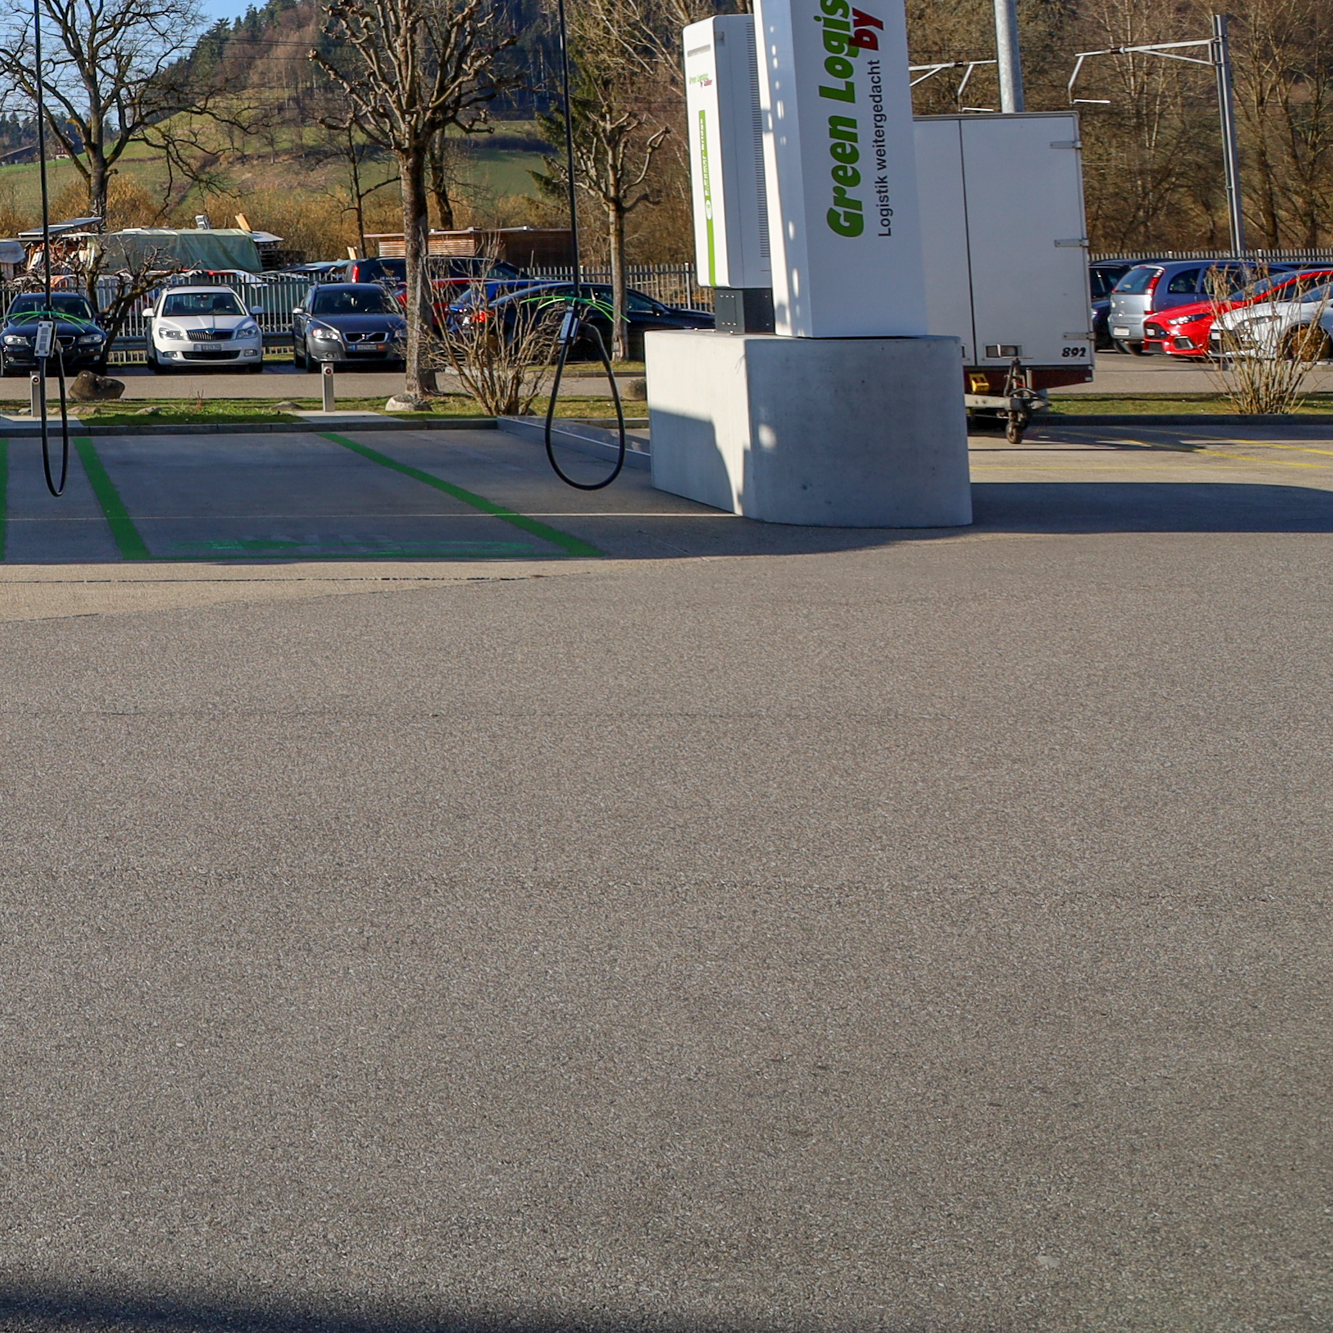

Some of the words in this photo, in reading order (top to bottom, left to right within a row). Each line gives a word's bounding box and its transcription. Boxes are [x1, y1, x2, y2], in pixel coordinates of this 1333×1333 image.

[848, 7, 885, 52] by
[867, 59, 888, 171] weitergedacht
[827, 115, 865, 238] Green
[875, 174, 894, 238] Logistik
